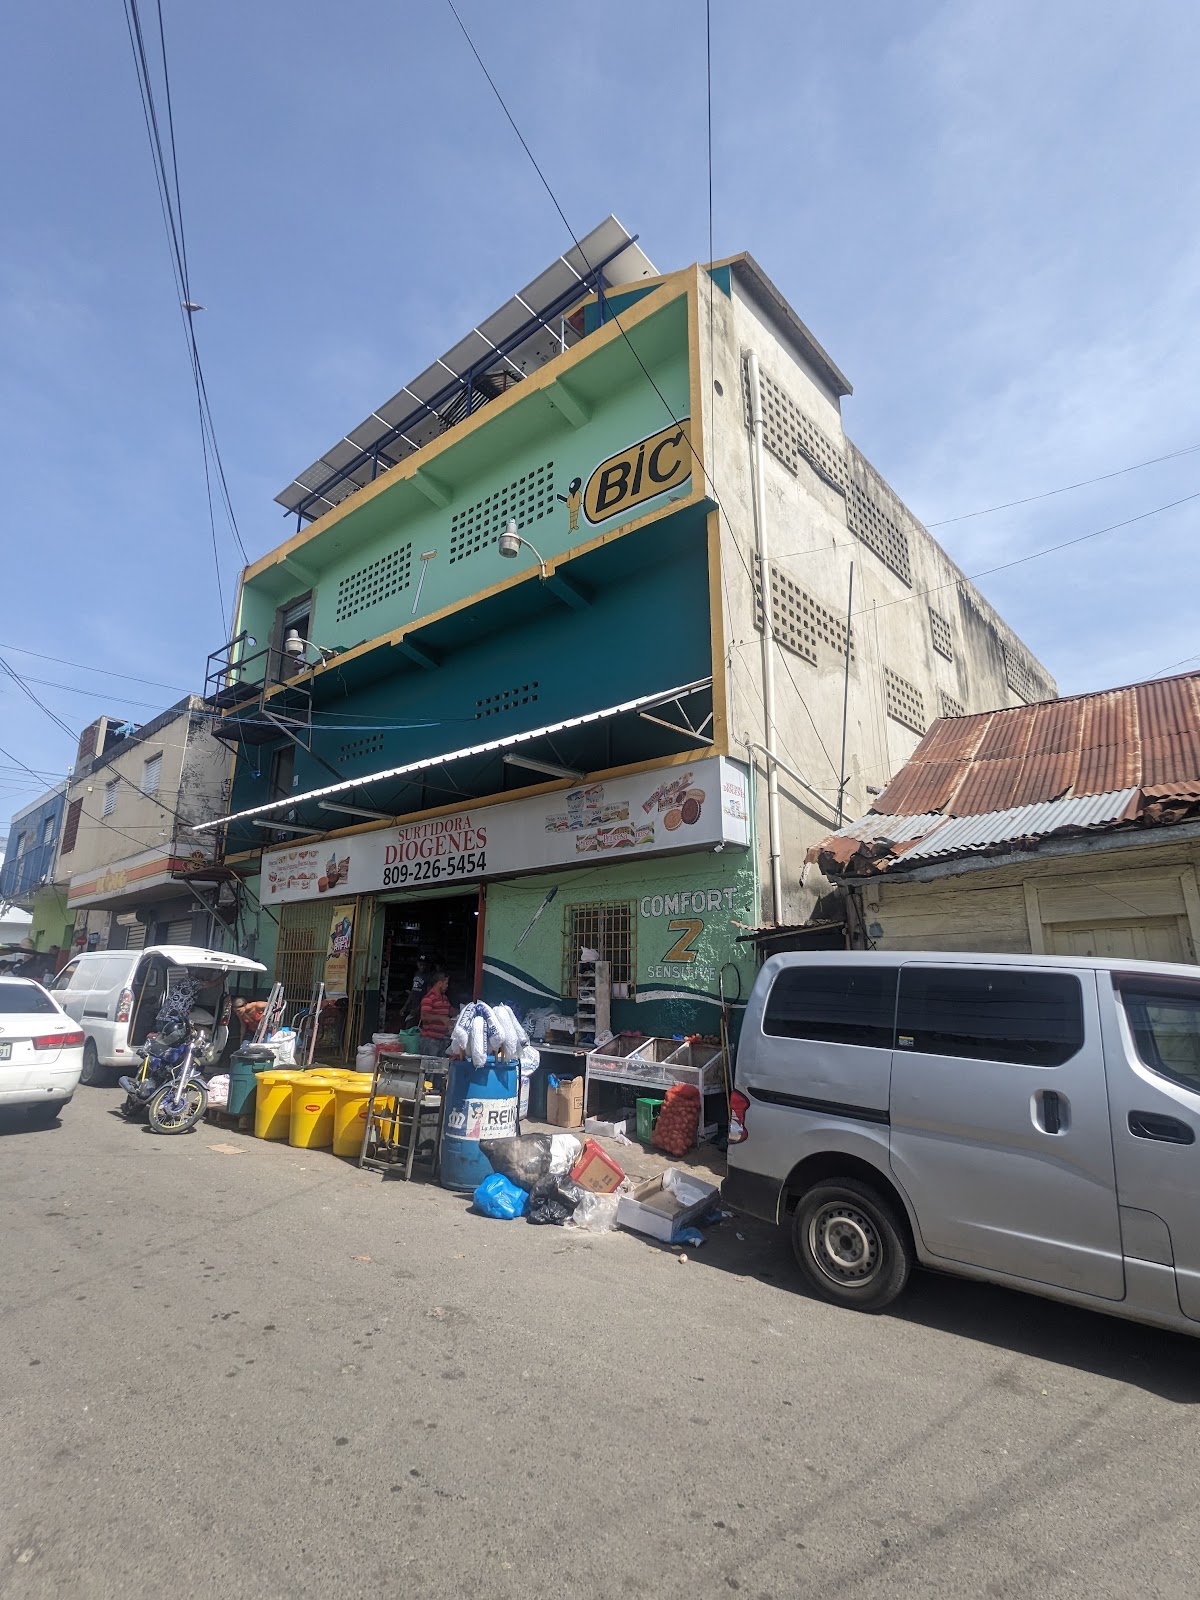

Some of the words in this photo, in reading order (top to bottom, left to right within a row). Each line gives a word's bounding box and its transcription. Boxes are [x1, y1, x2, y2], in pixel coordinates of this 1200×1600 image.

[398, 815, 472, 842] SURTIDORA
[384, 827, 487, 865] DIOGENES
[383, 852, 487, 886] 809-226-5454
[640, 887, 738, 918] COMFORT
